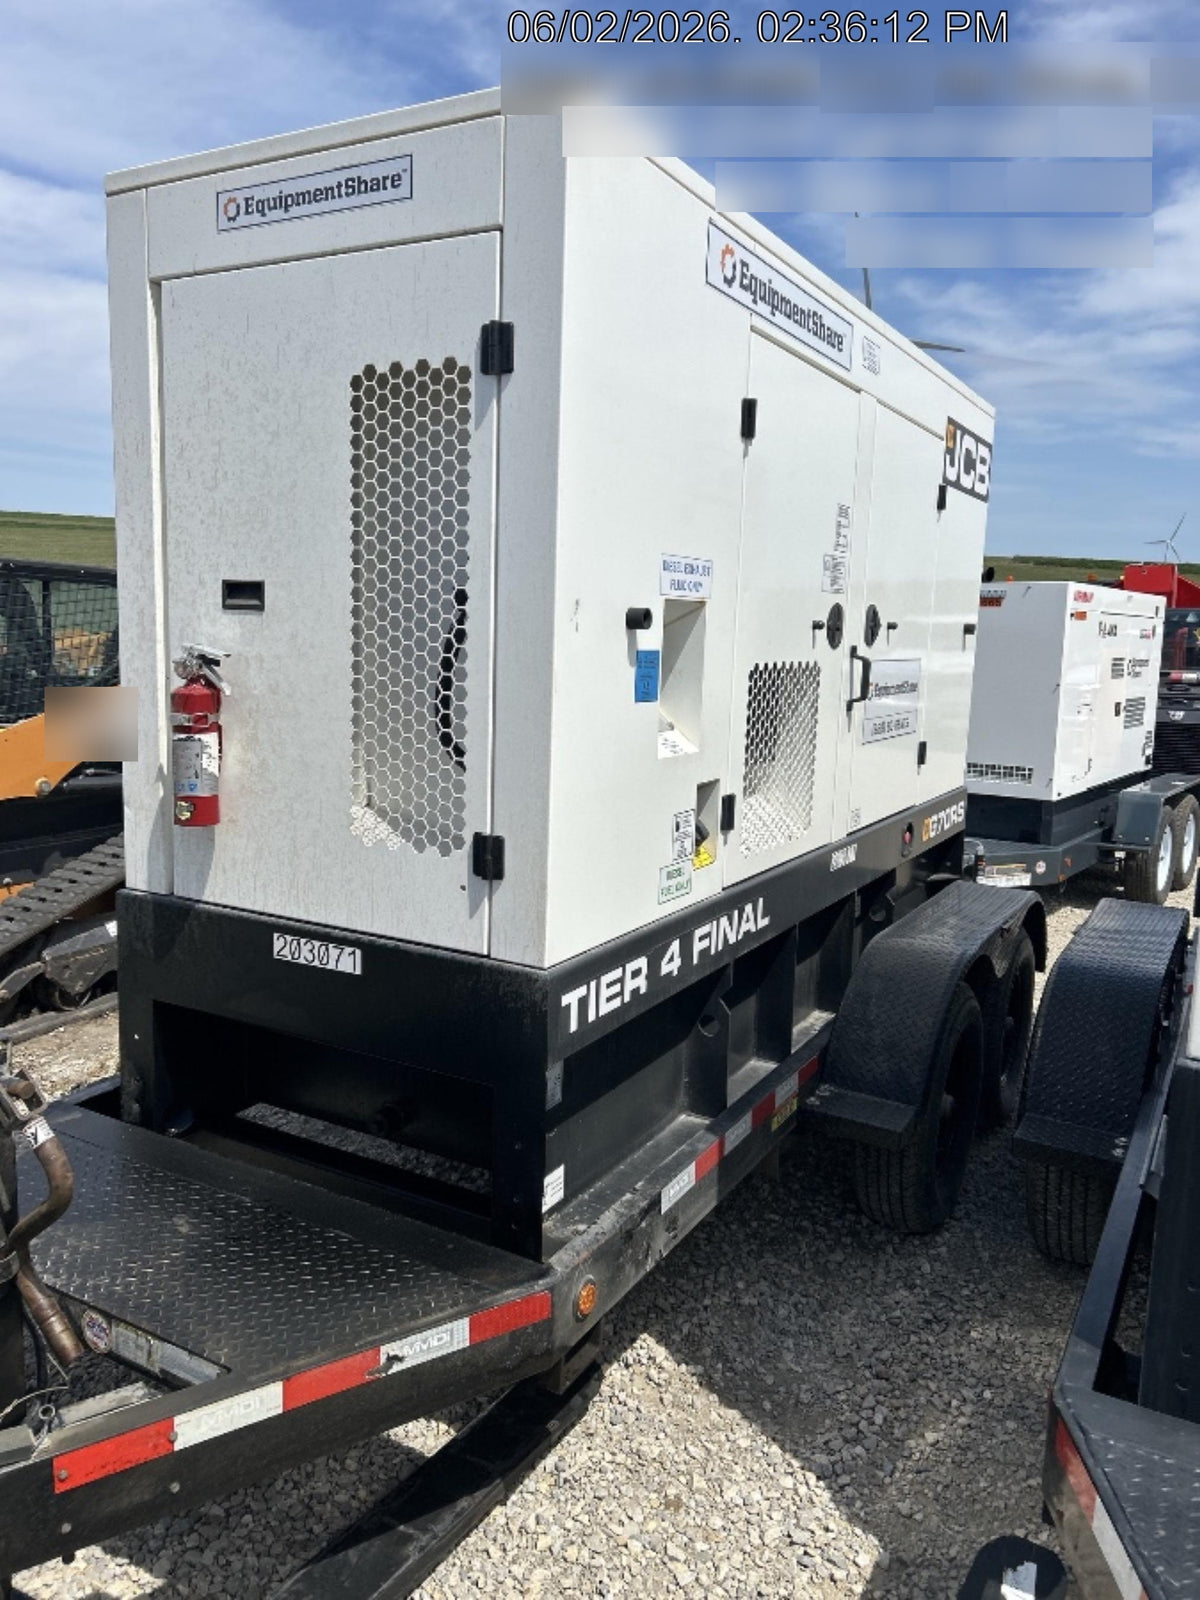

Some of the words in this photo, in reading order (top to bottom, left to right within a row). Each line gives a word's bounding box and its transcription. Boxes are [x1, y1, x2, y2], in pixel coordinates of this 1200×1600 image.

[244, 171, 403, 217] EquipmentShare
[740, 259, 844, 353] EquipmentShare
[945, 428, 991, 496] JCB
[275, 933, 357, 973] 203071
[561, 958, 649, 1035] TIER
[659, 938, 682, 978] 4
[692, 896, 771, 967] FINAL
